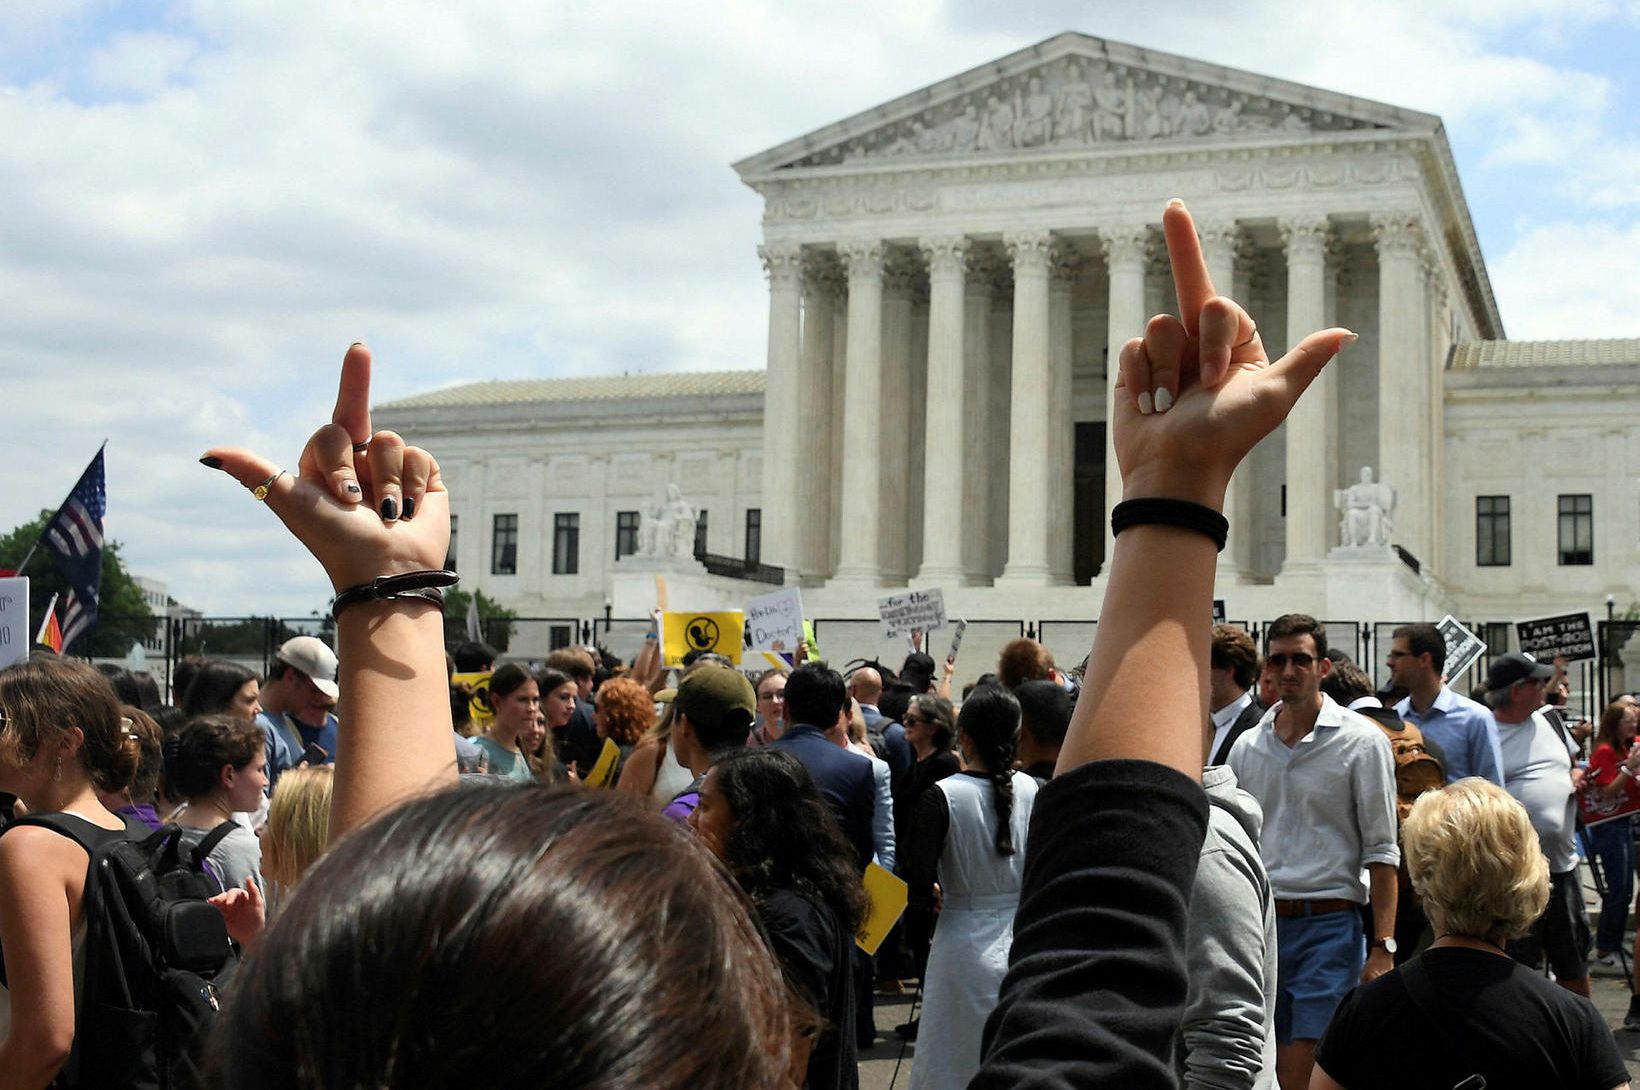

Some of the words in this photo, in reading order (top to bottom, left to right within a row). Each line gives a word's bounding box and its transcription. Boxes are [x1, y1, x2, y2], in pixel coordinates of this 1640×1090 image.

[910, 592, 929, 603] the
[1522, 629, 1527, 638] I
[1533, 625, 1554, 636] AM
[1559, 620, 1585, 632] THE
[1520, 630, 1591, 651] POST-ROE
